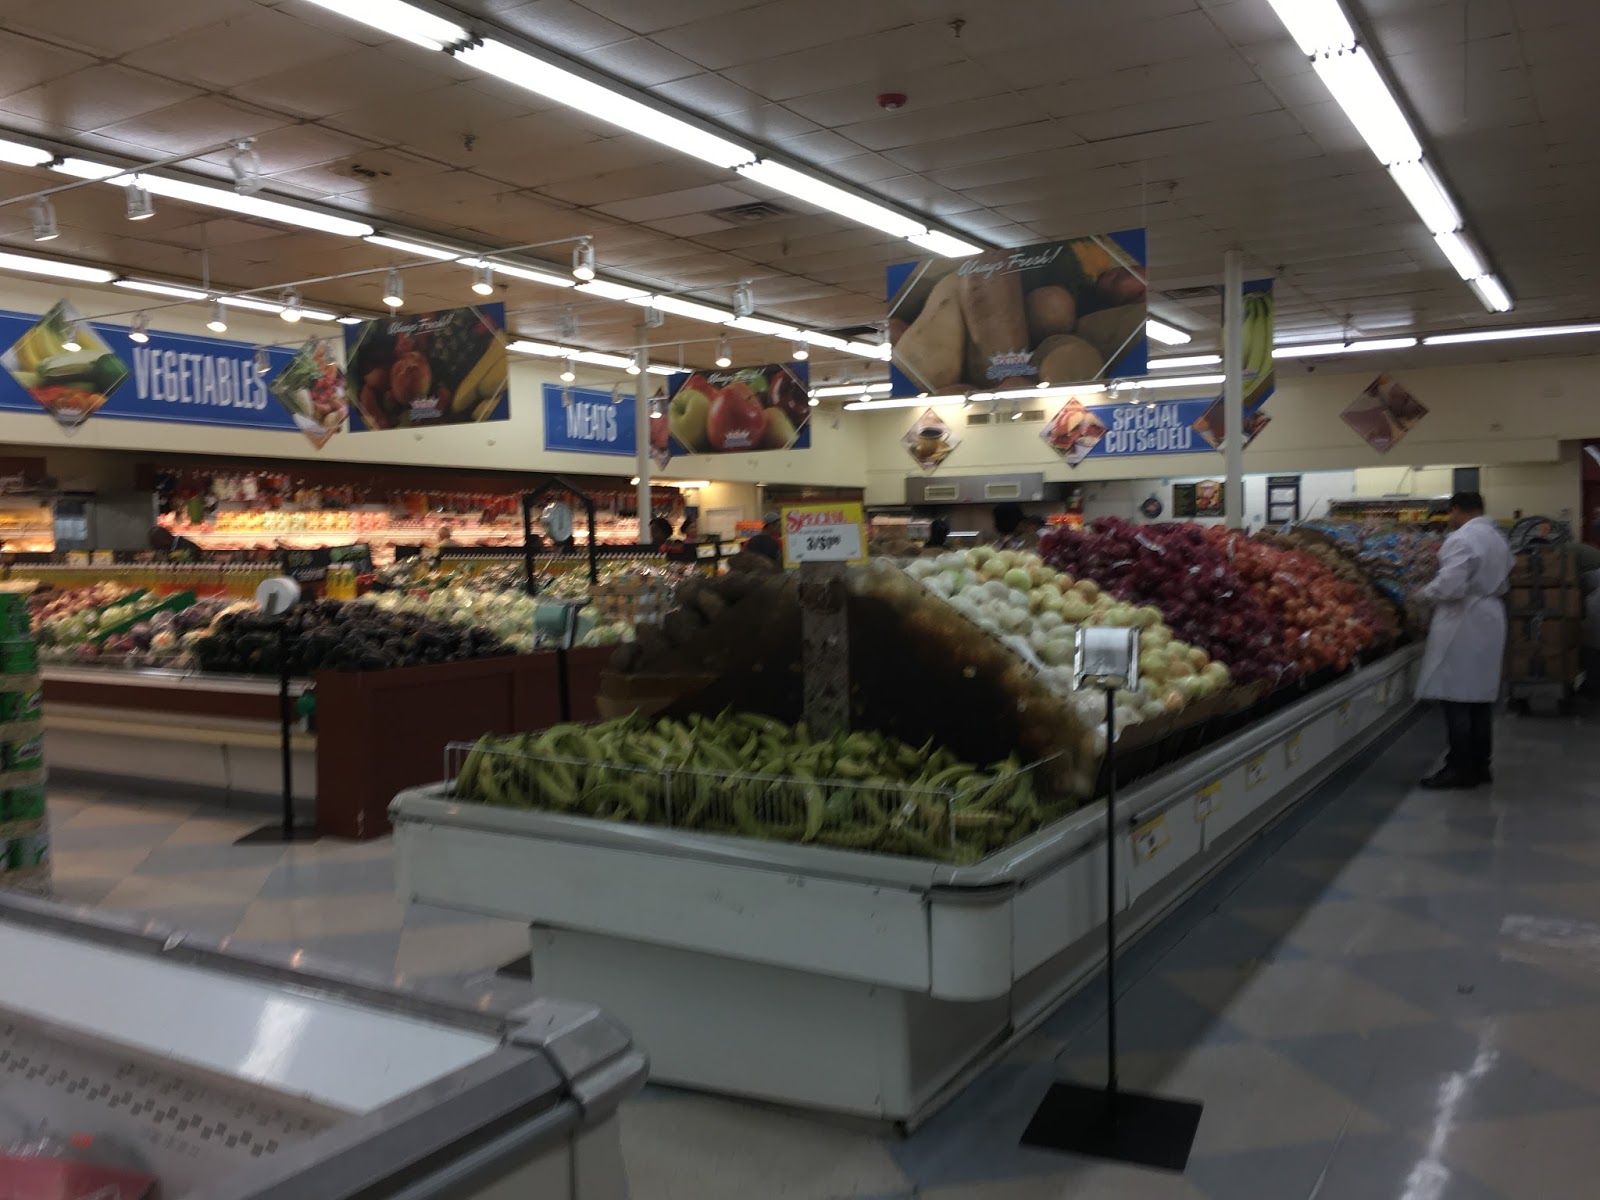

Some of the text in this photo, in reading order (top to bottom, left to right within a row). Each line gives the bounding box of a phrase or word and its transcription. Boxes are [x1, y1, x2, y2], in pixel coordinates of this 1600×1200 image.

[133, 347, 268, 411] VEGETABLES
[566, 401, 618, 443] MEATS
[1112, 404, 1183, 431] SPECIAL
